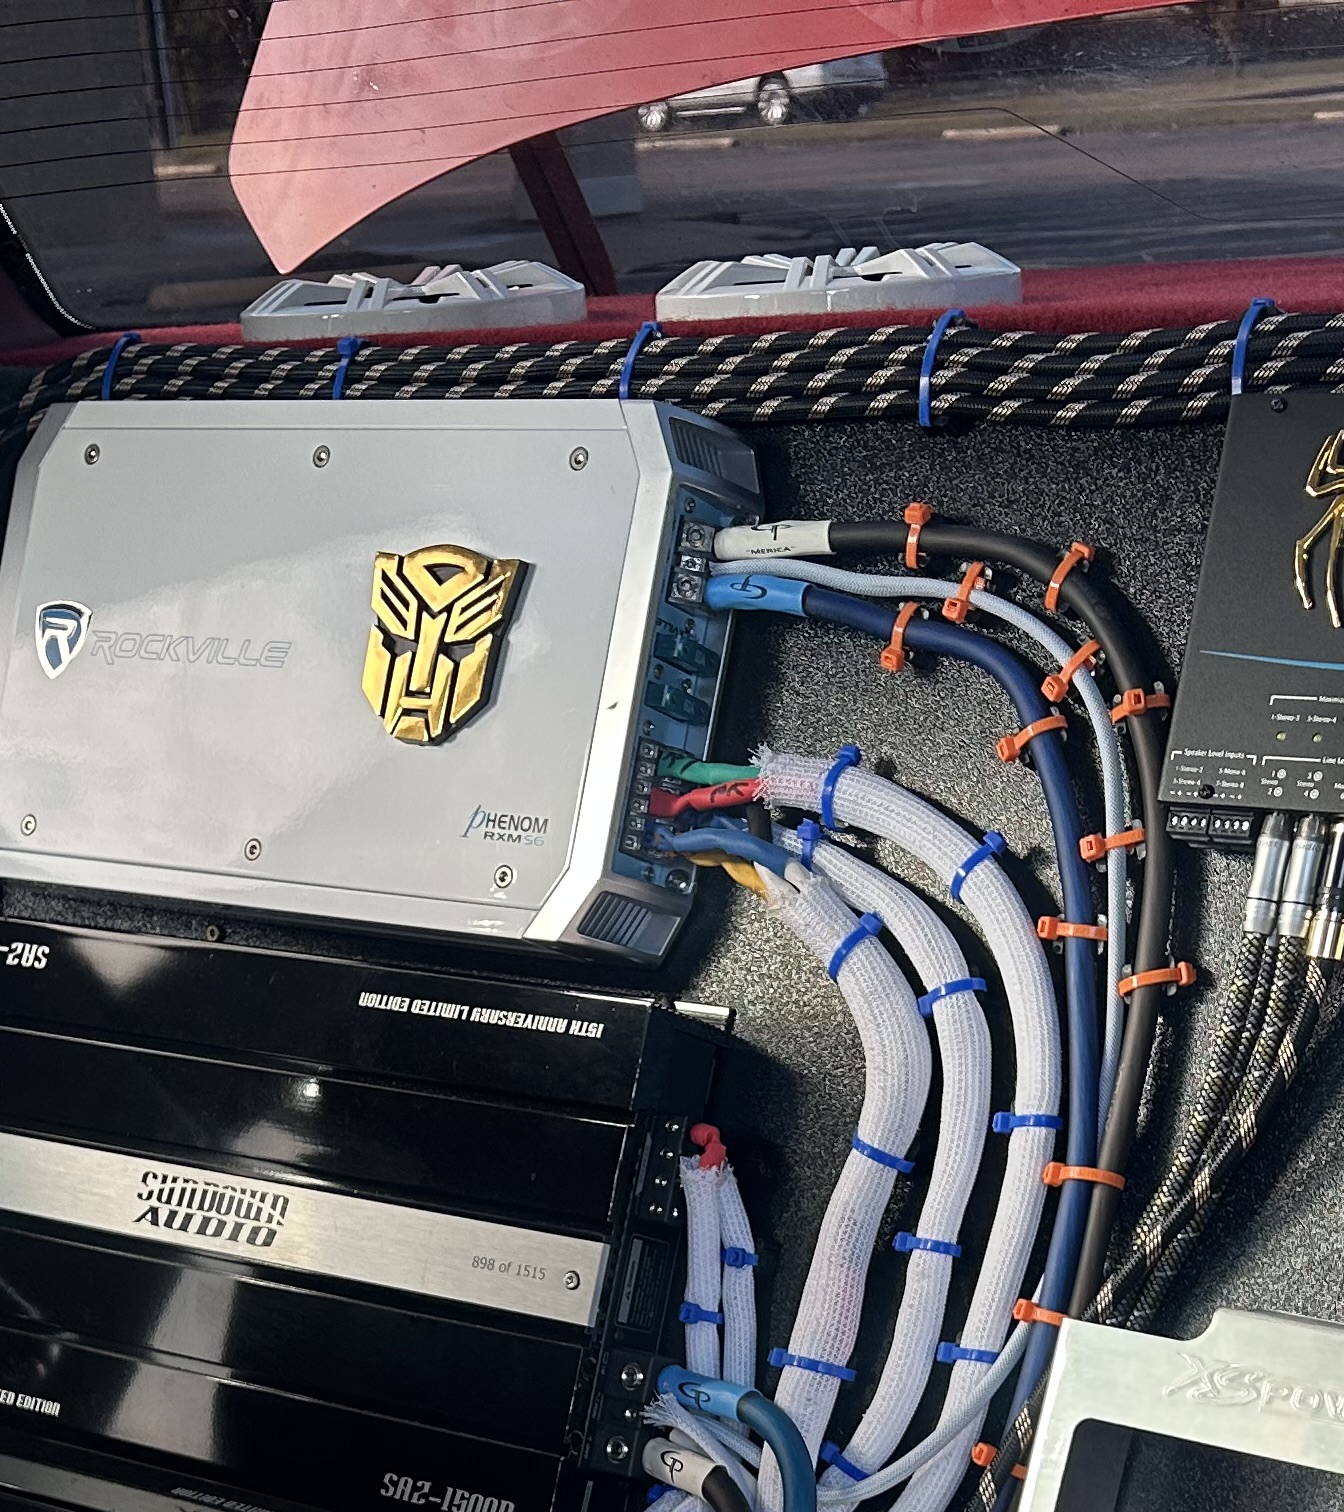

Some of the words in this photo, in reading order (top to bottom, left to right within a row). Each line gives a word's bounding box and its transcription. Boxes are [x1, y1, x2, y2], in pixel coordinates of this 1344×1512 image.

[91, 630, 293, 669] ROCKVILLE
[358, 992, 410, 1012] EDITION
[411, 998, 469, 1020] LIMITED
[470, 1007, 568, 1034] ANNIVERSARY
[569, 1019, 605, 1039] 15TH
[132, 1205, 277, 1247] AUDIO
[472, 1255, 495, 1271] 898
[498, 1261, 513, 1274] of
[516, 1264, 547, 1280] 1515
[16, 1393, 61, 1418] EDITION
